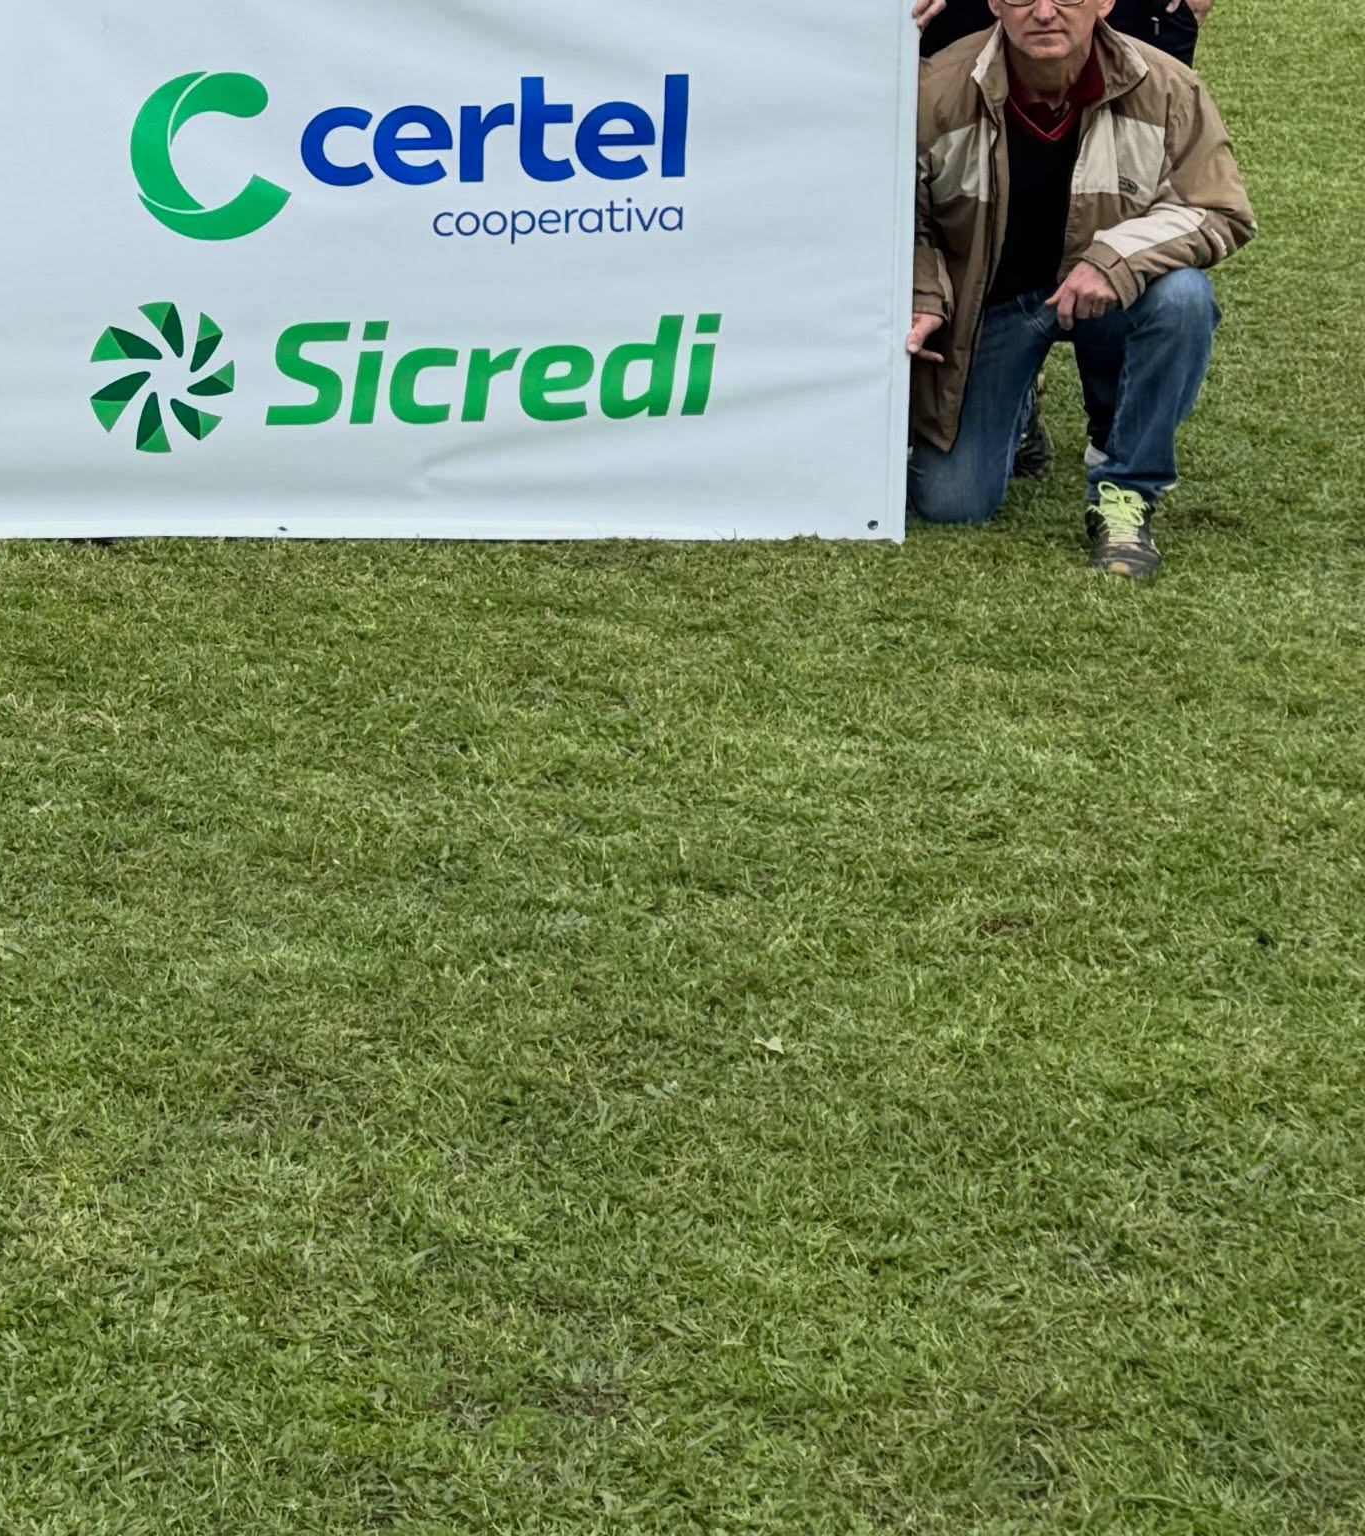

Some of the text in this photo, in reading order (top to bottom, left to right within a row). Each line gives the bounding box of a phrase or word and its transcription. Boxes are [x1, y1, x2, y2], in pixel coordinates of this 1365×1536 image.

[300, 73, 689, 186] certel
[432, 197, 684, 244] cooperativa
[266, 312, 722, 426] Sicredi
